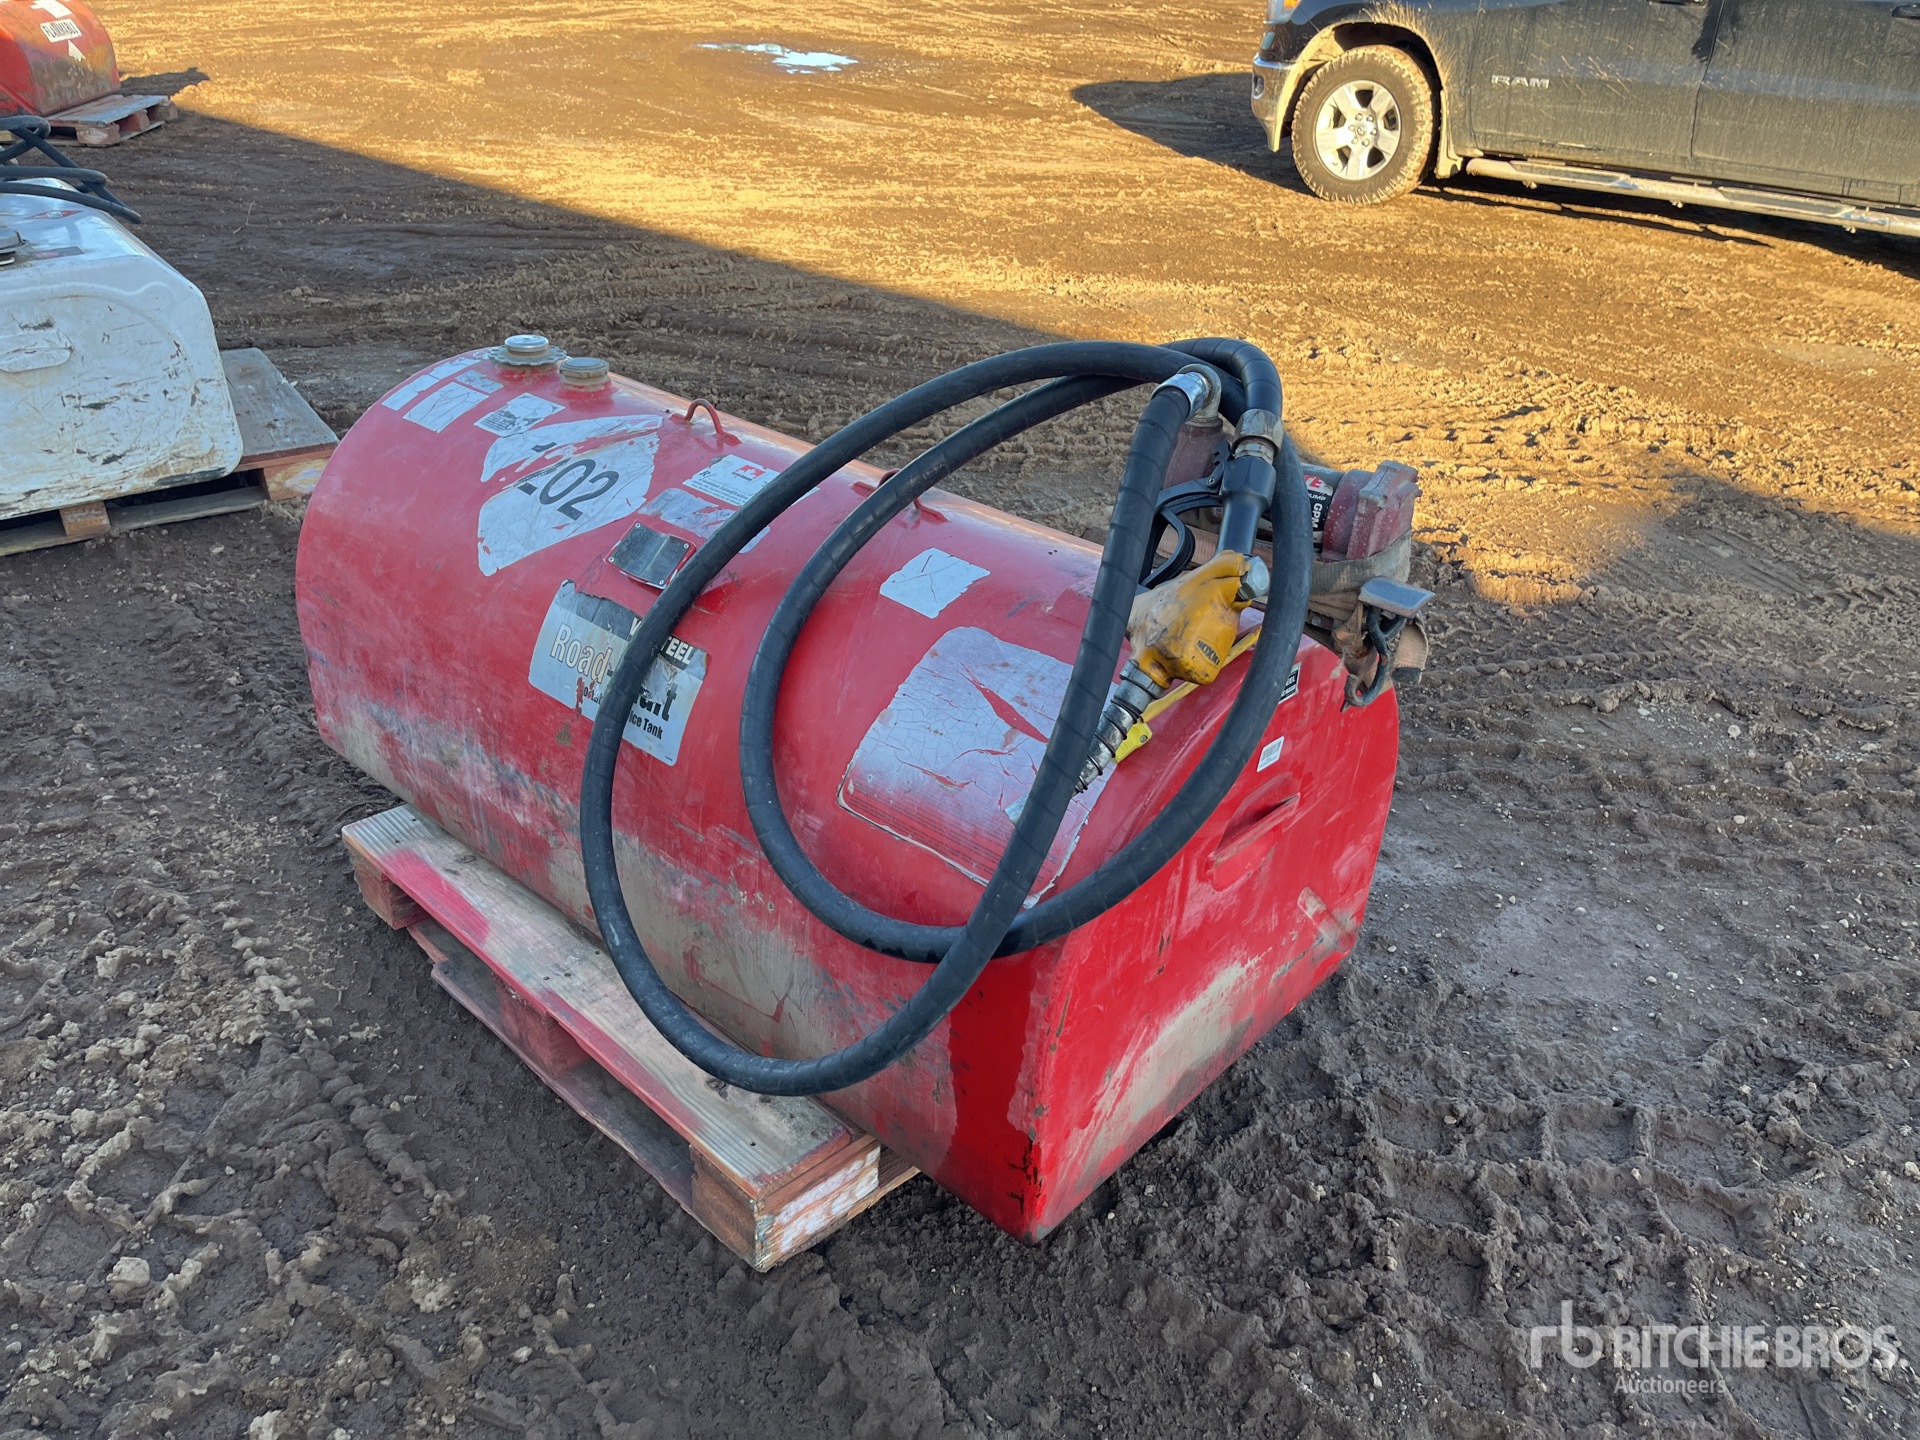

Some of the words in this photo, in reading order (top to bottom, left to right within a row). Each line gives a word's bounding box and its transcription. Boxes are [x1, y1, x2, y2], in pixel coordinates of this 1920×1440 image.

[1491, 75, 1550, 88] RAM
[661, 636, 693, 665] EEL
[643, 717, 664, 740] Tank
